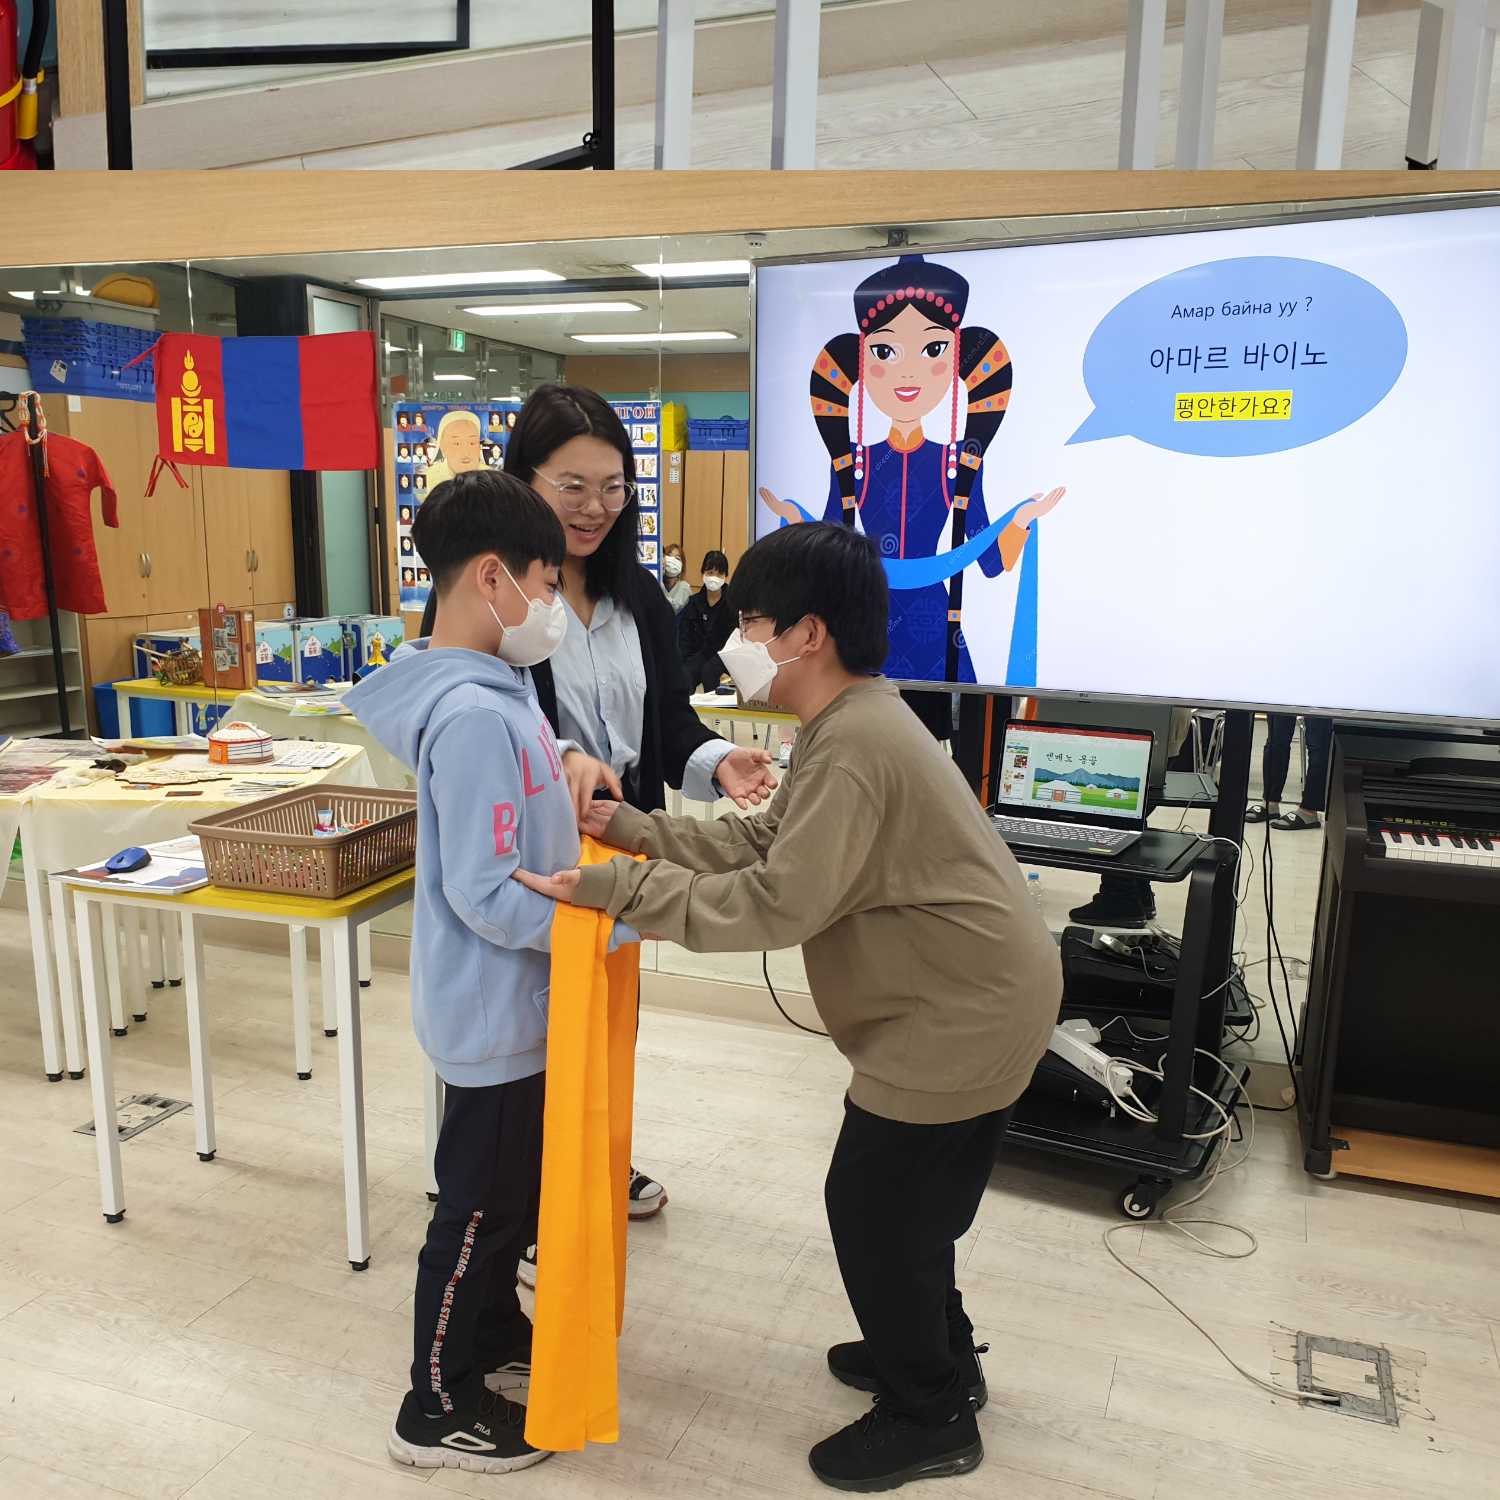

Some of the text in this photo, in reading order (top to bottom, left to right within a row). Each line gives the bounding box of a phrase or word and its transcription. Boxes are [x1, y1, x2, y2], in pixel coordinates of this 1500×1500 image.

[1171, 296, 1313, 321] Амар байна уу ?
[1150, 341, 1328, 374] 아마르 바이노
[614, 404, 656, 419] ЛГОЙ
[1176, 396, 1291, 419] 평안한가요?
[454, 1247, 471, 1278] STAGE
[436, 1307, 450, 1336] STAGE
[430, 1366, 441, 1393] STAG
[474, 1422, 490, 1436] FILA
